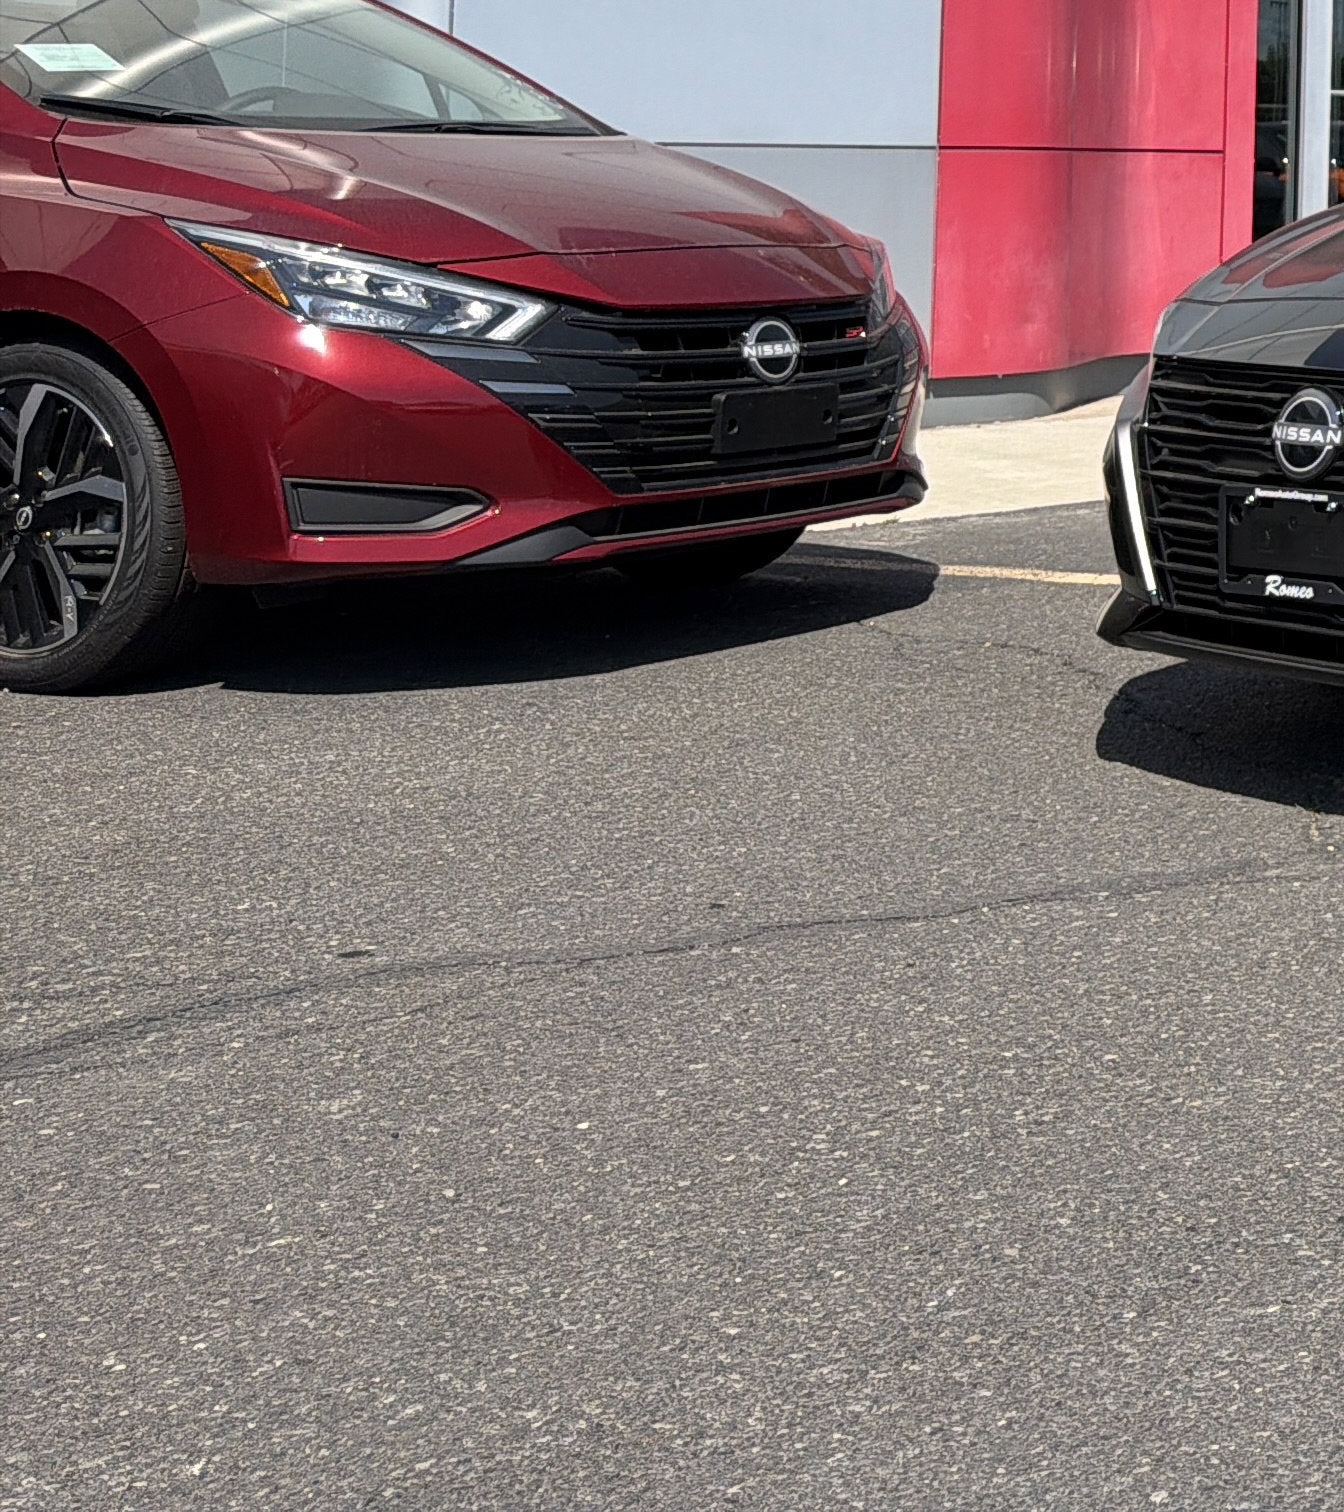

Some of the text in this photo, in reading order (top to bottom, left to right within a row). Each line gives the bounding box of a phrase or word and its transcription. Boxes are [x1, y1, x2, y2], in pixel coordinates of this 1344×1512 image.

[743, 341, 800, 358] NISSAN
[1272, 423, 1342, 445] NISSAN
[1264, 574, 1315, 600] Romeo
